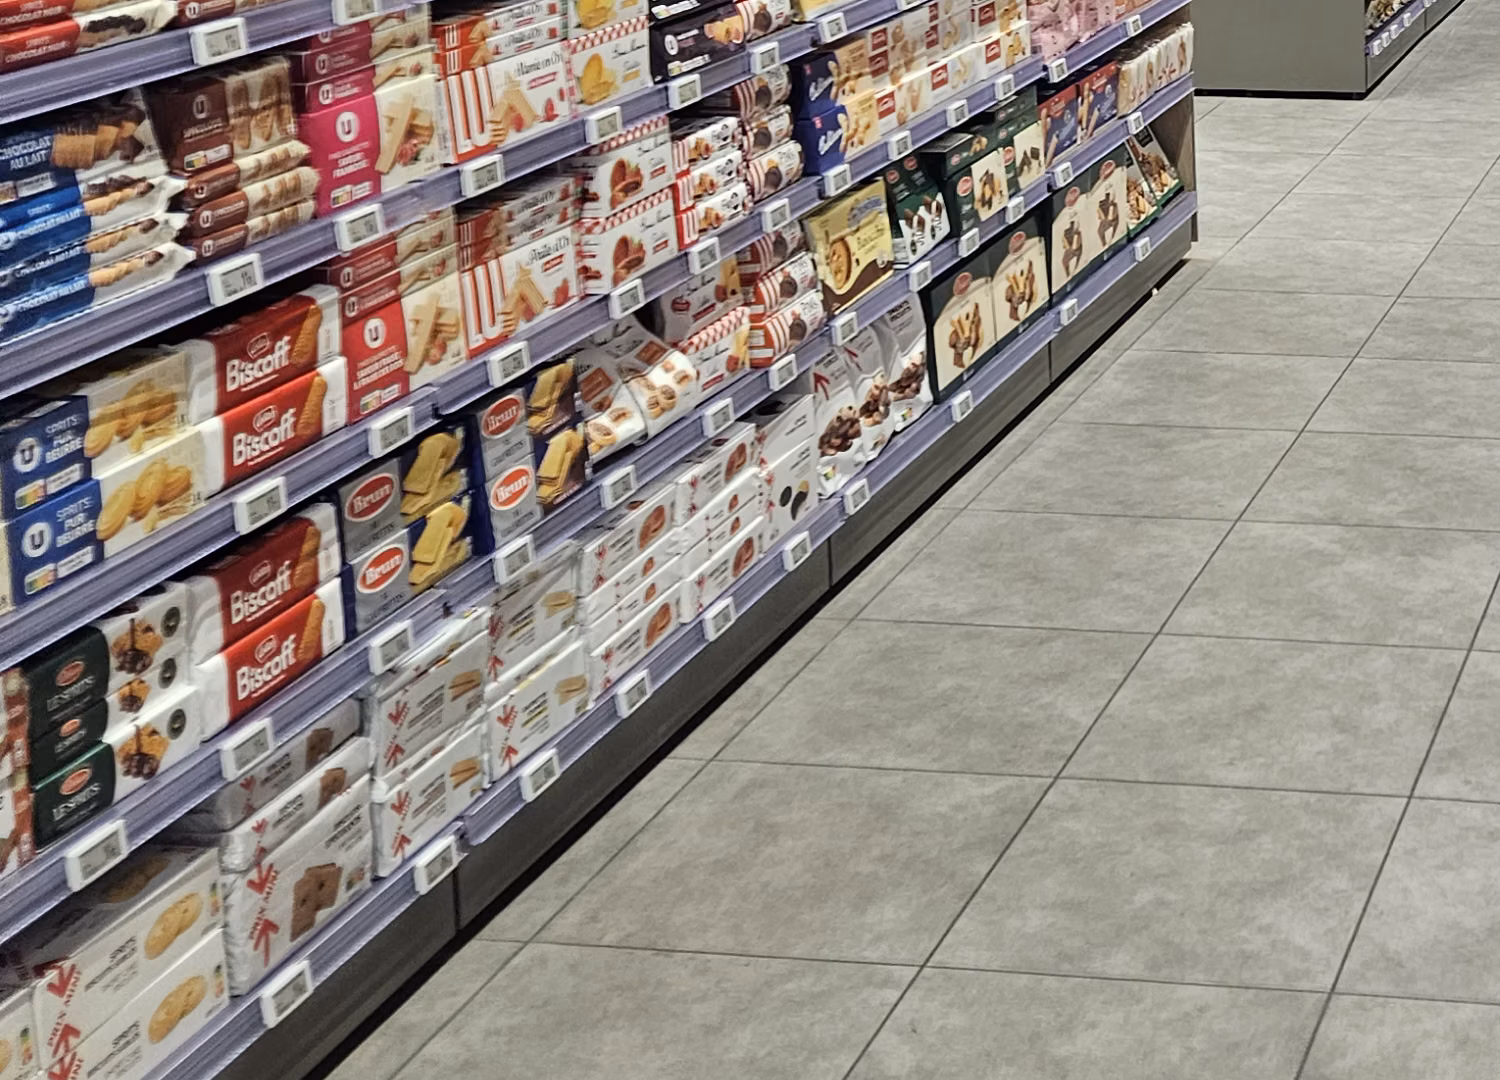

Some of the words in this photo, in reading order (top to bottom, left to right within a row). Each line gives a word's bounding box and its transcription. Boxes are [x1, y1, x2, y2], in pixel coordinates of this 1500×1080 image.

[226, 335, 291, 392] Biscoff
[233, 408, 297, 467] Biscoff
[352, 483, 392, 514] Brun
[495, 476, 528, 504] Brun
[230, 560, 292, 625] Biscoff
[364, 553, 402, 587] Brun
[236, 633, 297, 701] Biscoff
